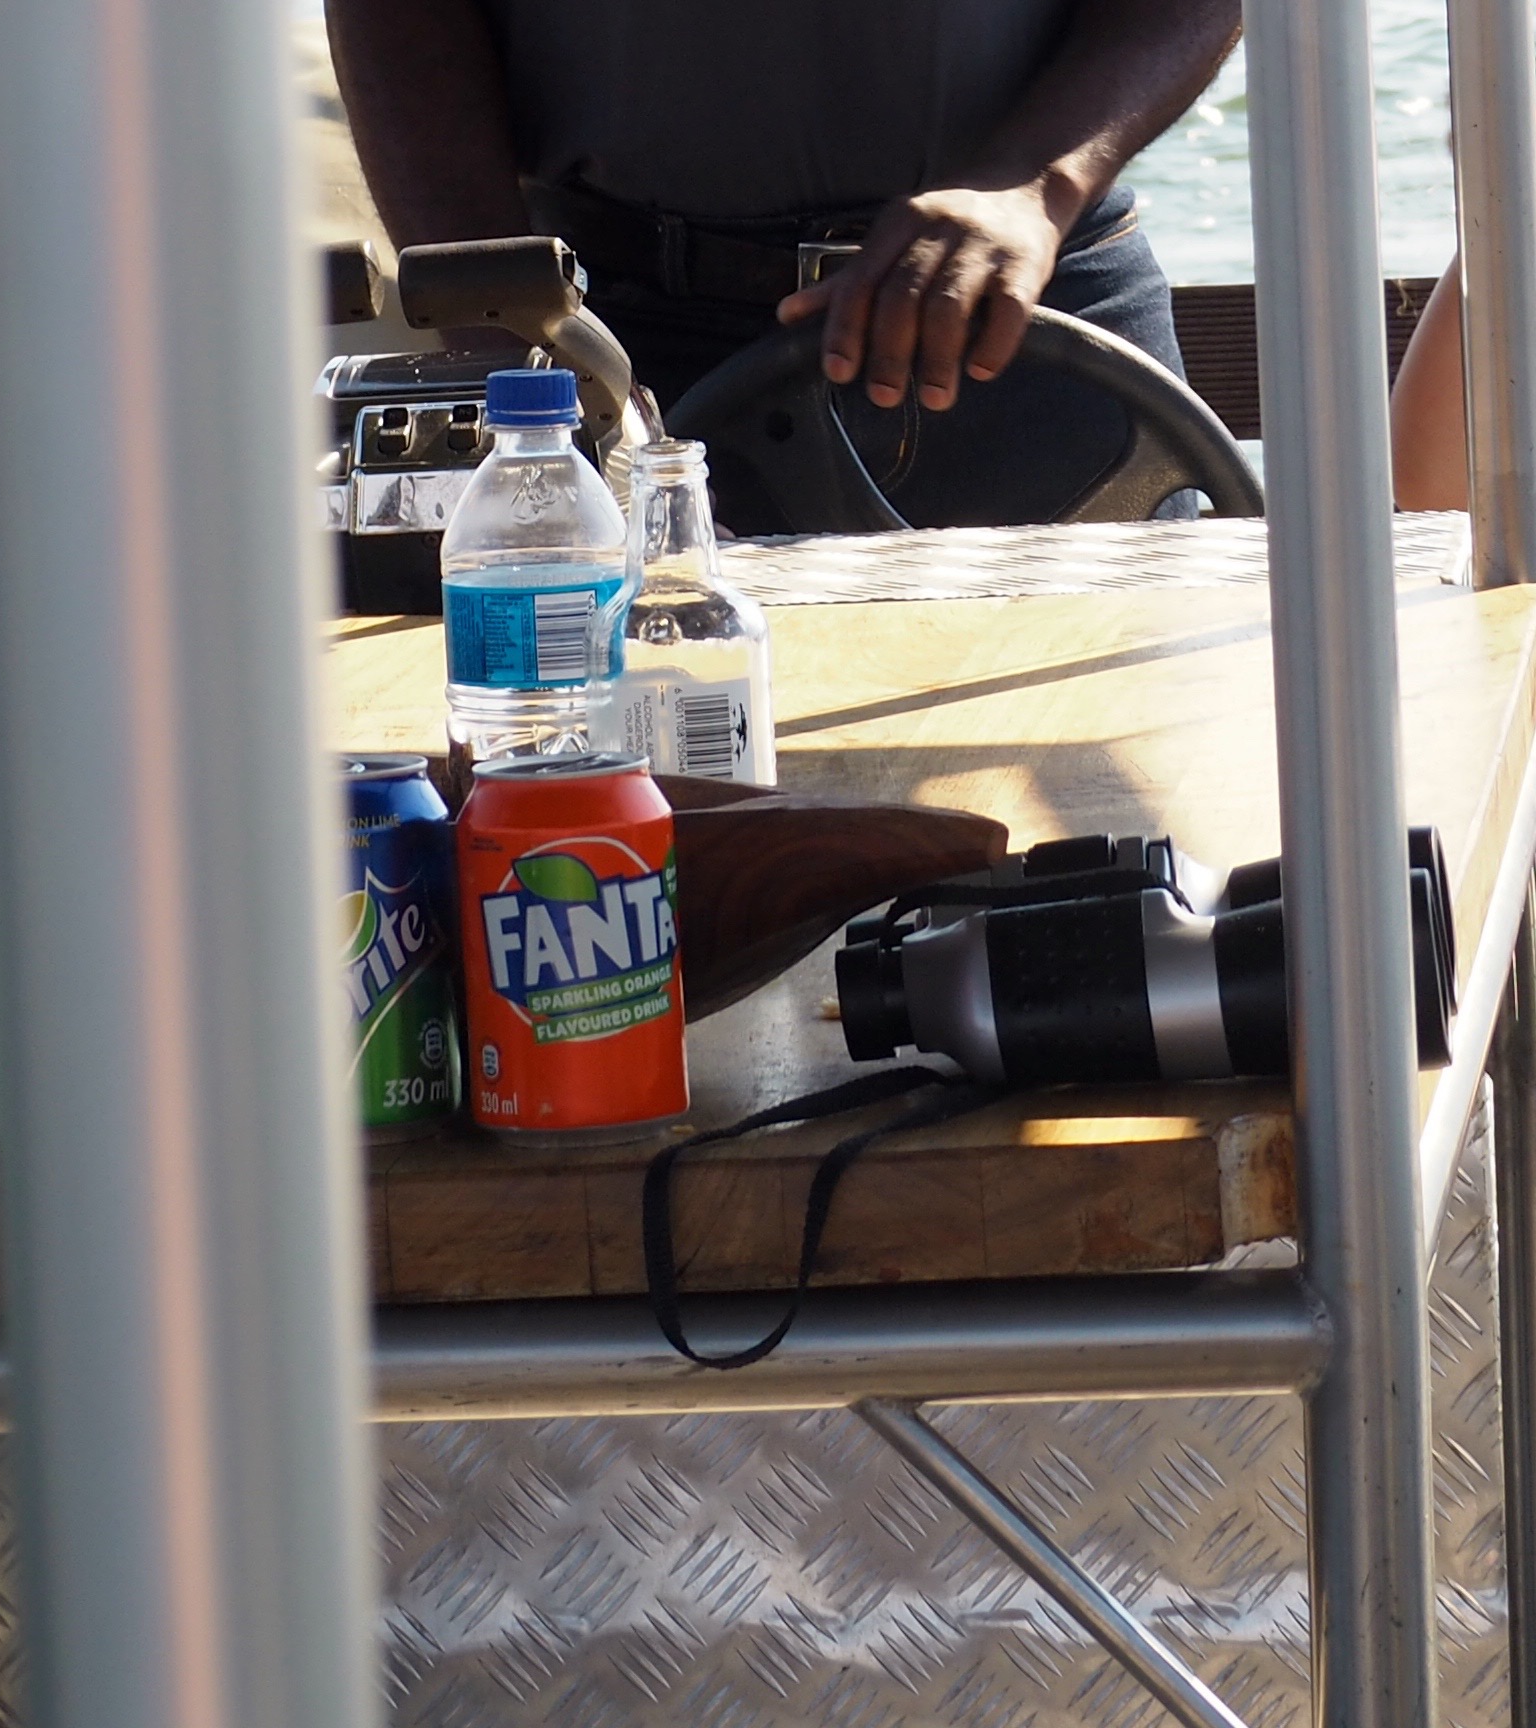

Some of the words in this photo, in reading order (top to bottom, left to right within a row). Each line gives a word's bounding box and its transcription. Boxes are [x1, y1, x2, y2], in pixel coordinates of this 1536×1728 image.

[644, 694, 653, 739] ALCOHOL
[370, 813, 401, 829] LIME
[482, 875, 678, 990] FANTA
[344, 903, 425, 1017] rite
[531, 979, 623, 1013] SPARKLING
[624, 966, 672, 994] ORANGE
[537, 1009, 632, 1040] FLAVOURED
[634, 995, 670, 1019] DRINK
[382, 1076, 424, 1109] 330
[430, 1065, 449, 1102] ml
[481, 1092, 499, 1115] 330
[501, 1092, 519, 1116] ml
